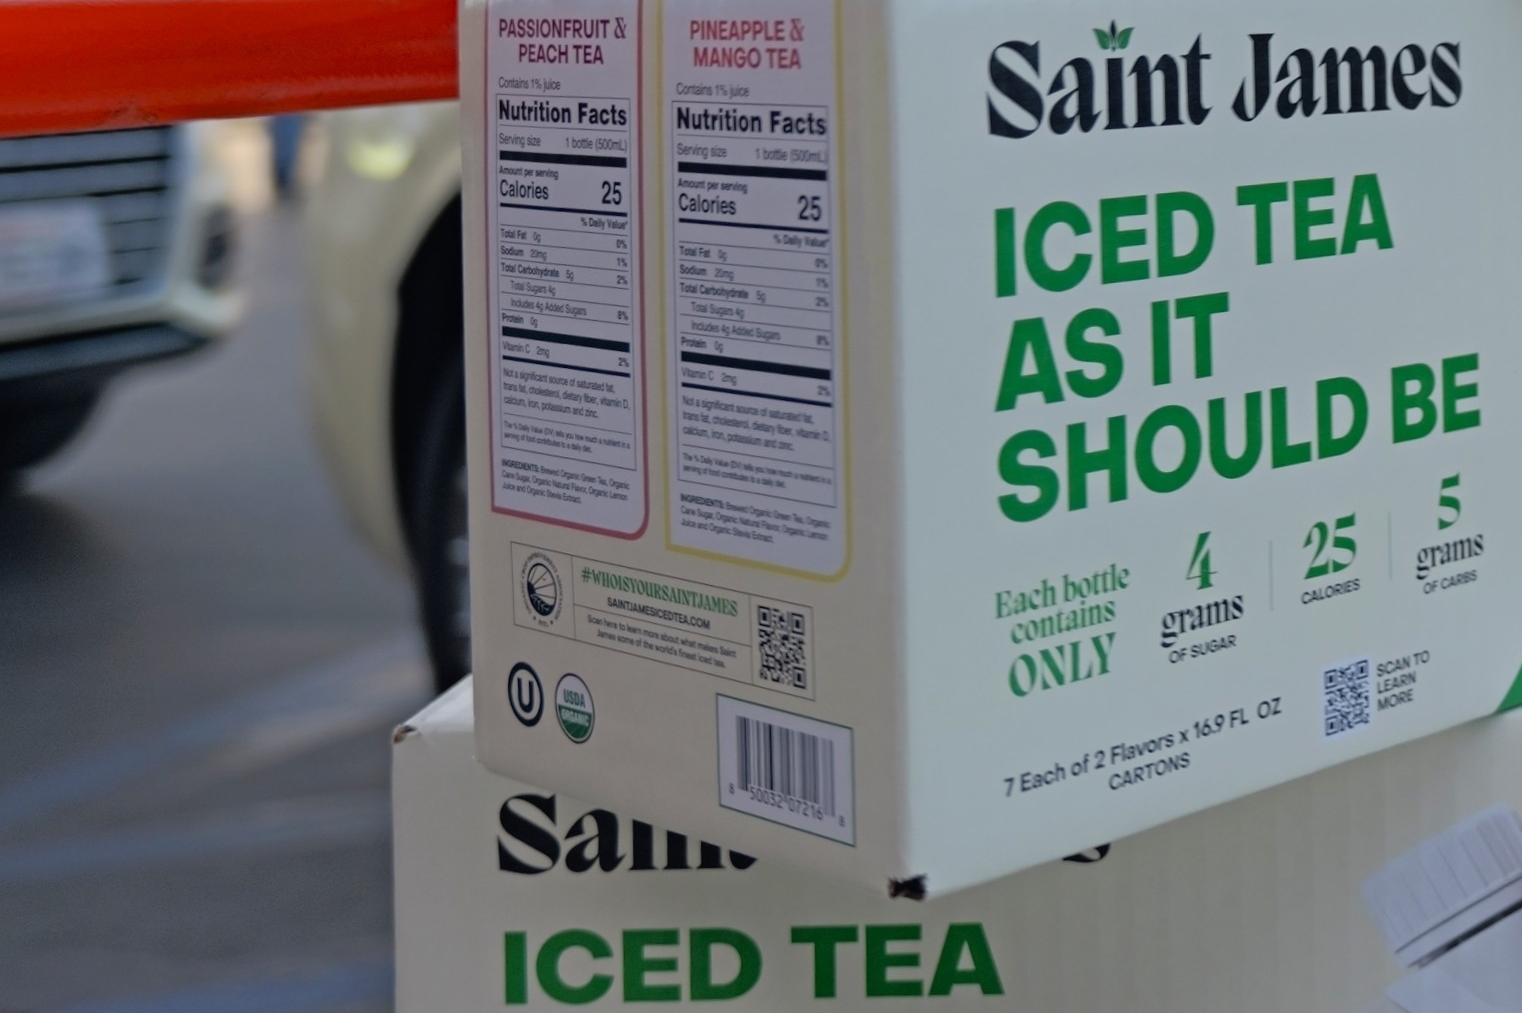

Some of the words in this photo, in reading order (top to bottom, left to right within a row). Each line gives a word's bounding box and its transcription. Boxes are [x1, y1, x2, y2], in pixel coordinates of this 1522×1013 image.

[499, 18, 610, 38] PASSIONFRUIT
[614, 17, 627, 39] &
[690, 20, 785, 41] PINEAPPLE
[790, 18, 804, 41] &
[519, 44, 568, 63] PEACH
[573, 45, 604, 65] TEA
[693, 47, 762, 69] MANGO
[766, 48, 801, 69] TEA
[498, 77, 529, 90] Contains
[531, 78, 542, 90] 1%
[543, 79, 561, 92] juice
[986, 32, 1213, 139] Saint
[1232, 33, 1463, 123] James
[499, 99, 571, 123] Nutrition
[578, 102, 627, 125] Facts
[677, 107, 762, 133] Nutrition
[770, 111, 826, 135] Facts
[499, 133, 525, 147] Serving
[527, 135, 541, 147] size
[572, 137, 593, 149] bottle
[595, 139, 628, 153] (500mL)
[677, 143, 708, 159] Serving
[711, 145, 727, 157] size
[500, 179, 549, 200] Calories
[601, 180, 622, 206] 25
[678, 193, 737, 215] Calories
[797, 195, 822, 222] 25
[994, 190, 1216, 299] ICED
[1236, 172, 1395, 266] TEA
[994, 307, 1124, 413] AS
[1151, 292, 1230, 387] IT
[997, 375, 1369, 523] SHOULD
[1391, 352, 1481, 444] BE
[1437, 473, 1461, 530] 5
[1185, 531, 1218, 590] 4
[1302, 512, 1357, 580] 25
[1416, 533, 1484, 581] grams
[581, 566, 738, 617] #WHOISYOURSAINTJAMES
[995, 576, 1056, 620] Each
[1061, 563, 1130, 603] bottle
[1301, 578, 1361, 605] CALORIES
[1423, 581, 1438, 594] OF
[1441, 571, 1478, 592] CARBS
[607, 597, 710, 629] SAINTJAMESICEDTEA.COM
[1009, 599, 1116, 645] contains
[1160, 594, 1244, 649] grams
[1008, 631, 1117, 698] ONLY
[1168, 649, 1187, 664] OF
[1190, 636, 1237, 660] SUGAR
[1377, 656, 1412, 678] SCAN
[1413, 651, 1430, 666] TO
[1377, 671, 1417, 695] LEARN
[563, 688, 585, 708] USDA
[1377, 689, 1414, 711] MORE
[561, 708, 590, 727] ORGANIC
[1003, 779, 1015, 797] 7
[1020, 764, 1066, 795] Each
[1070, 755, 1090, 776] of
[1094, 751, 1106, 769] 2
[1110, 733, 1175, 765] Flavors
[1178, 730, 1190, 743] x
[1193, 715, 1226, 740] 16.9
[1230, 708, 1249, 730] FL
[1256, 698, 1282, 720] OZ
[1108, 752, 1191, 791] CARTONS
[497, 794, 758, 876] Sain
[504, 928, 763, 1006] ICED
[790, 922, 1005, 999] TEA
